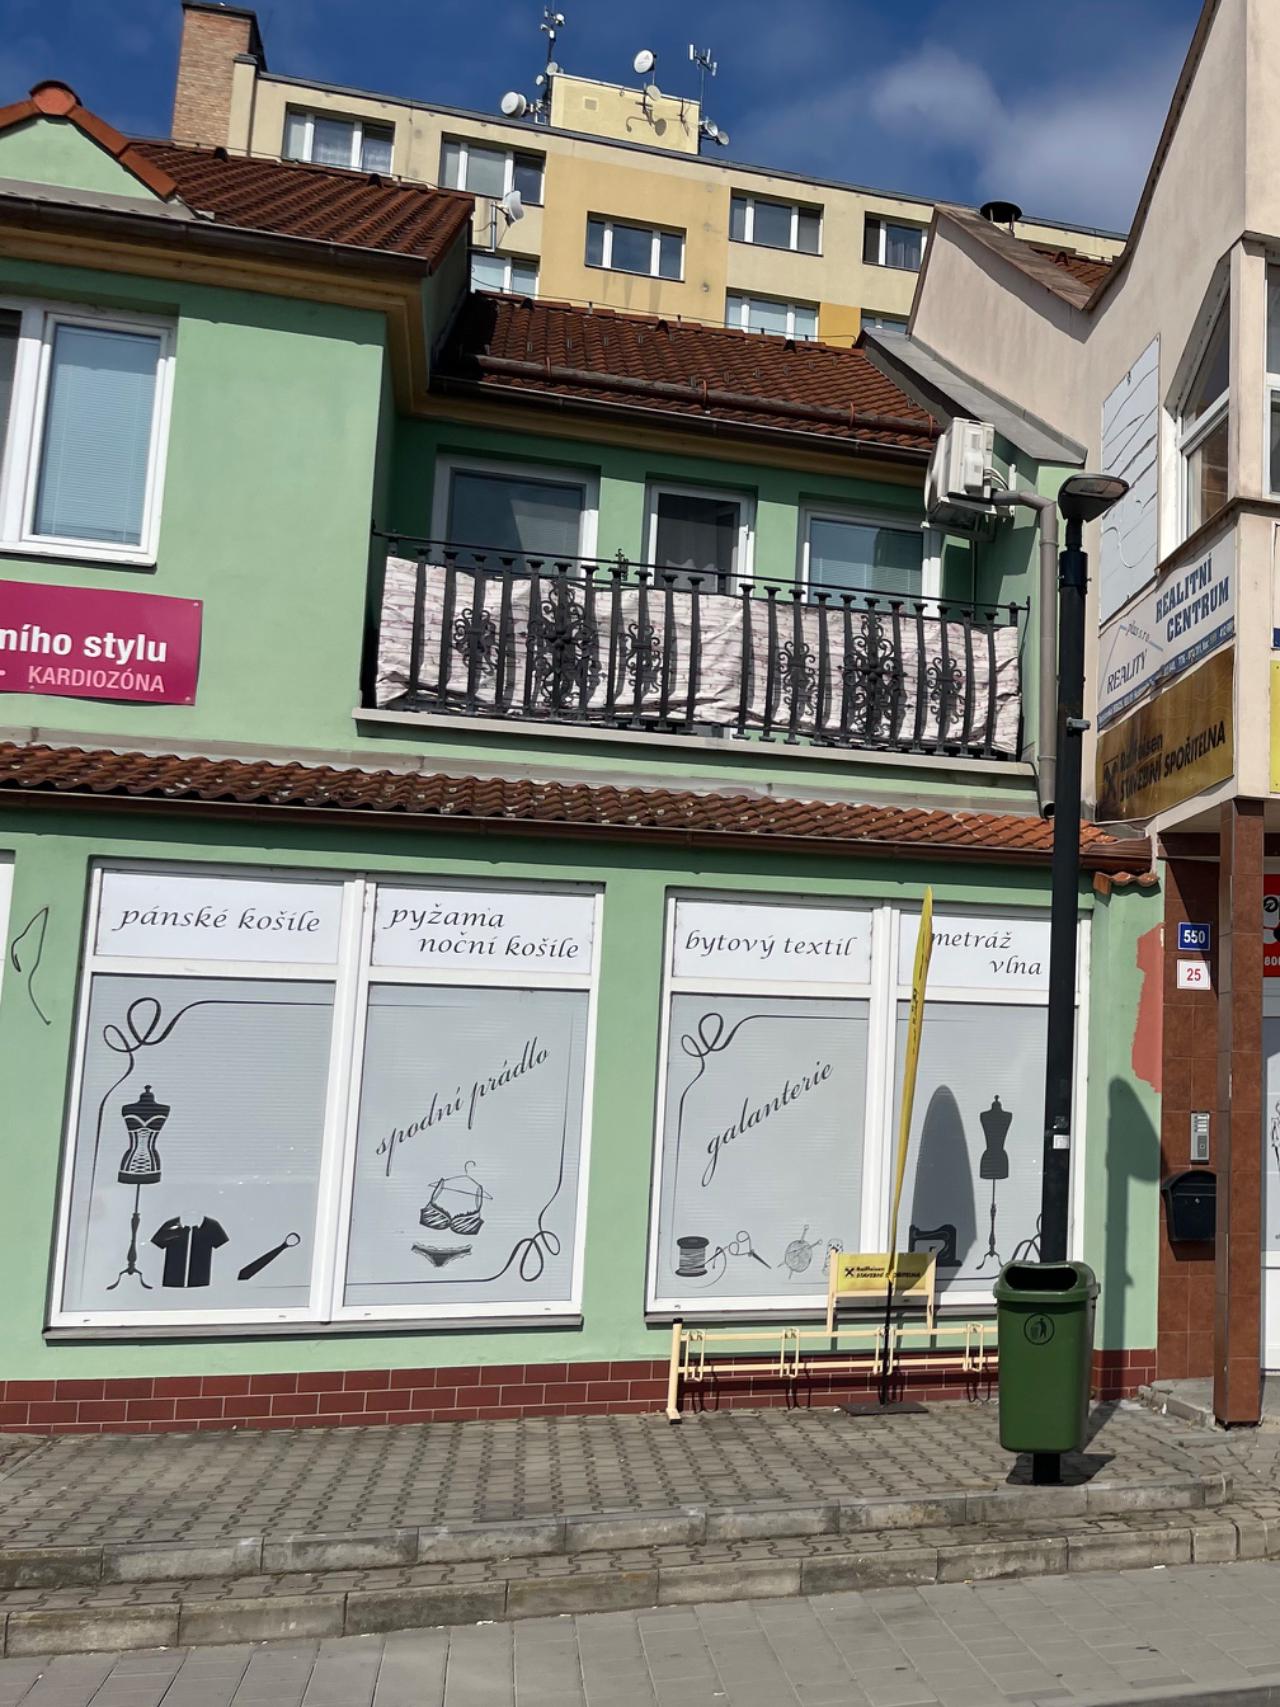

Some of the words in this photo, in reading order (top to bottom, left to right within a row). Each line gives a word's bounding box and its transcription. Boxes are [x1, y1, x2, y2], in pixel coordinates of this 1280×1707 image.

[1155, 552, 1212, 624] REALITNÍ
[1166, 576, 1229, 643] CENTRUM
[83, 632, 168, 666] stylu
[28, 665, 165, 693] KARDIOZÓNA
[1106, 648, 1148, 694] REALITY
[1163, 720, 1226, 778] SPOŘITELNA
[111, 905, 228, 931] pánské
[383, 904, 505, 931] pyžama
[418, 931, 498, 956] noční
[685, 929, 775, 960] bytový
[783, 935, 858, 956] textil
[931, 931, 1013, 950] metráž
[1184, 930, 1206, 944] 550
[990, 956, 1042, 976] vlna
[1187, 968, 1201, 981] 25
[376, 1086, 463, 1177] spodní
[467, 1036, 549, 1130] prádlo
[701, 1060, 834, 1188] galanterie
